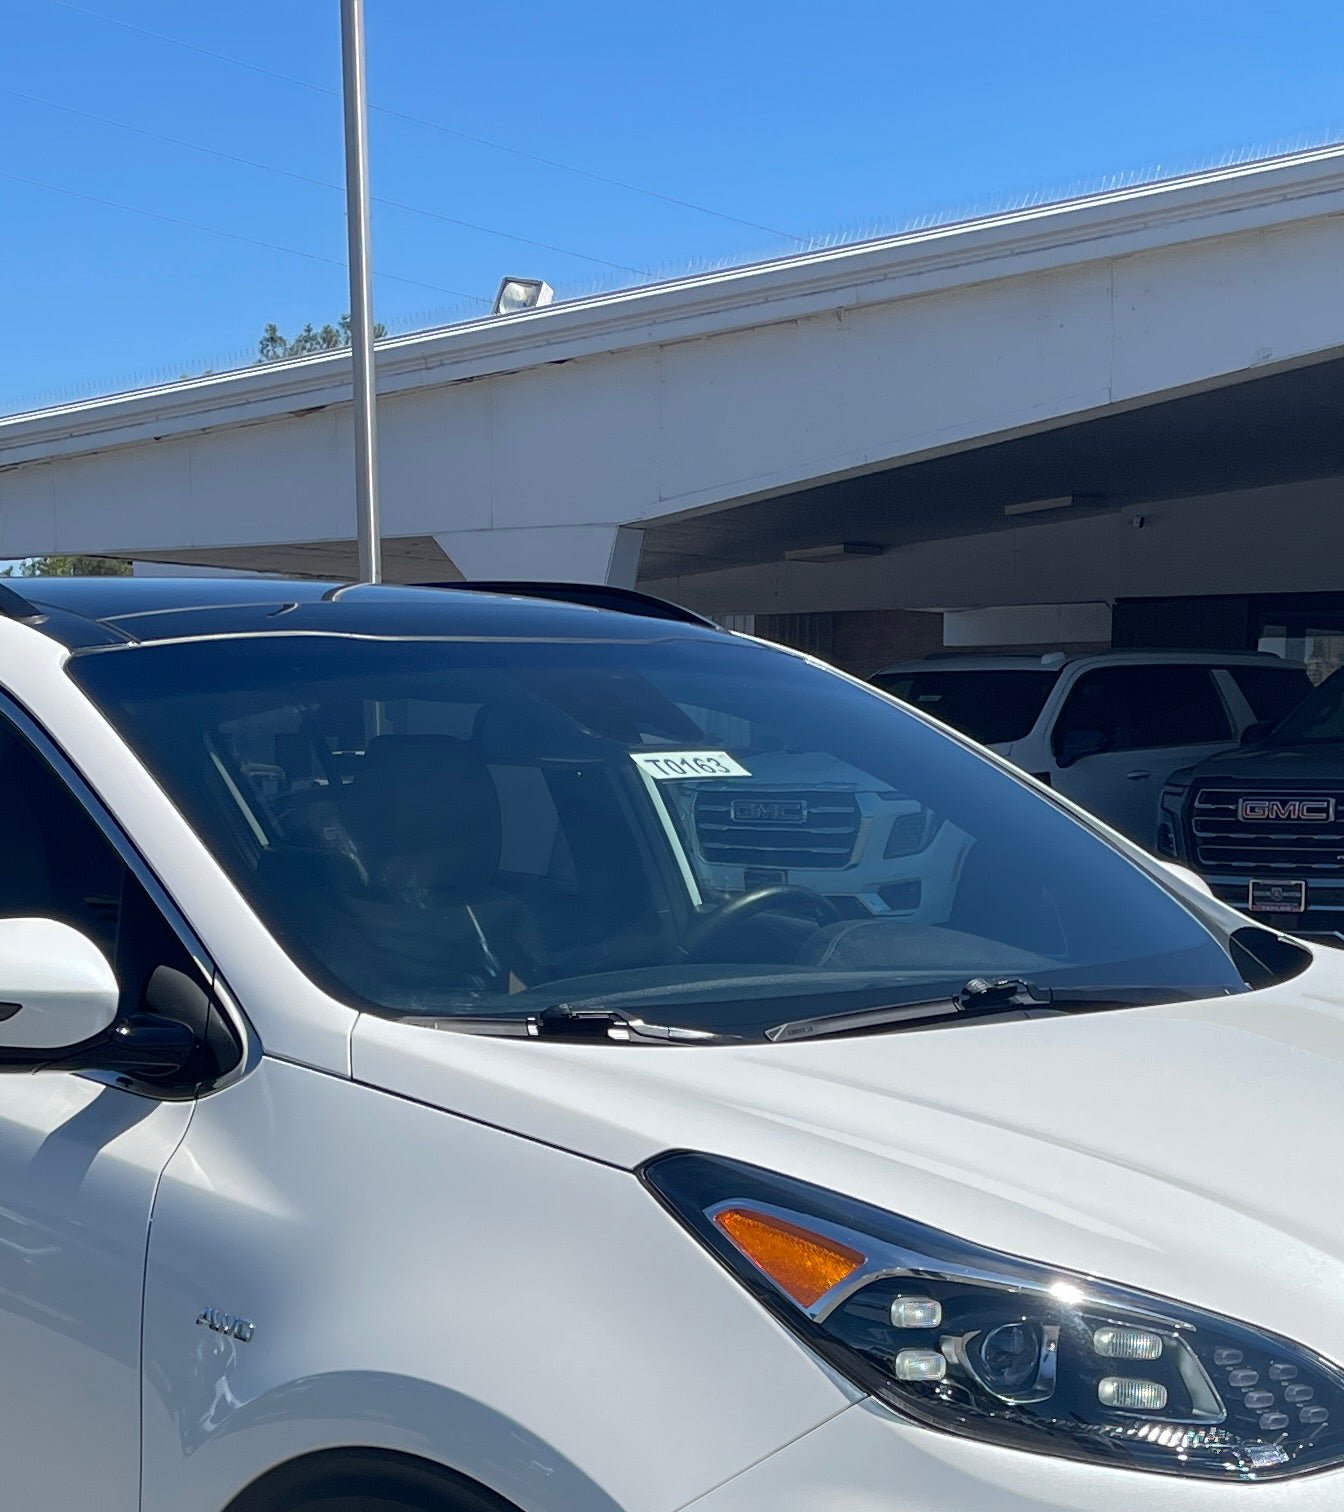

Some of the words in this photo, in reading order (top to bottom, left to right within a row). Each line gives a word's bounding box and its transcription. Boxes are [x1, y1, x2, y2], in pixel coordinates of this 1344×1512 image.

[643, 757, 731, 776] T0163
[735, 803, 802, 820] GMC
[1242, 801, 1328, 819] GMC
